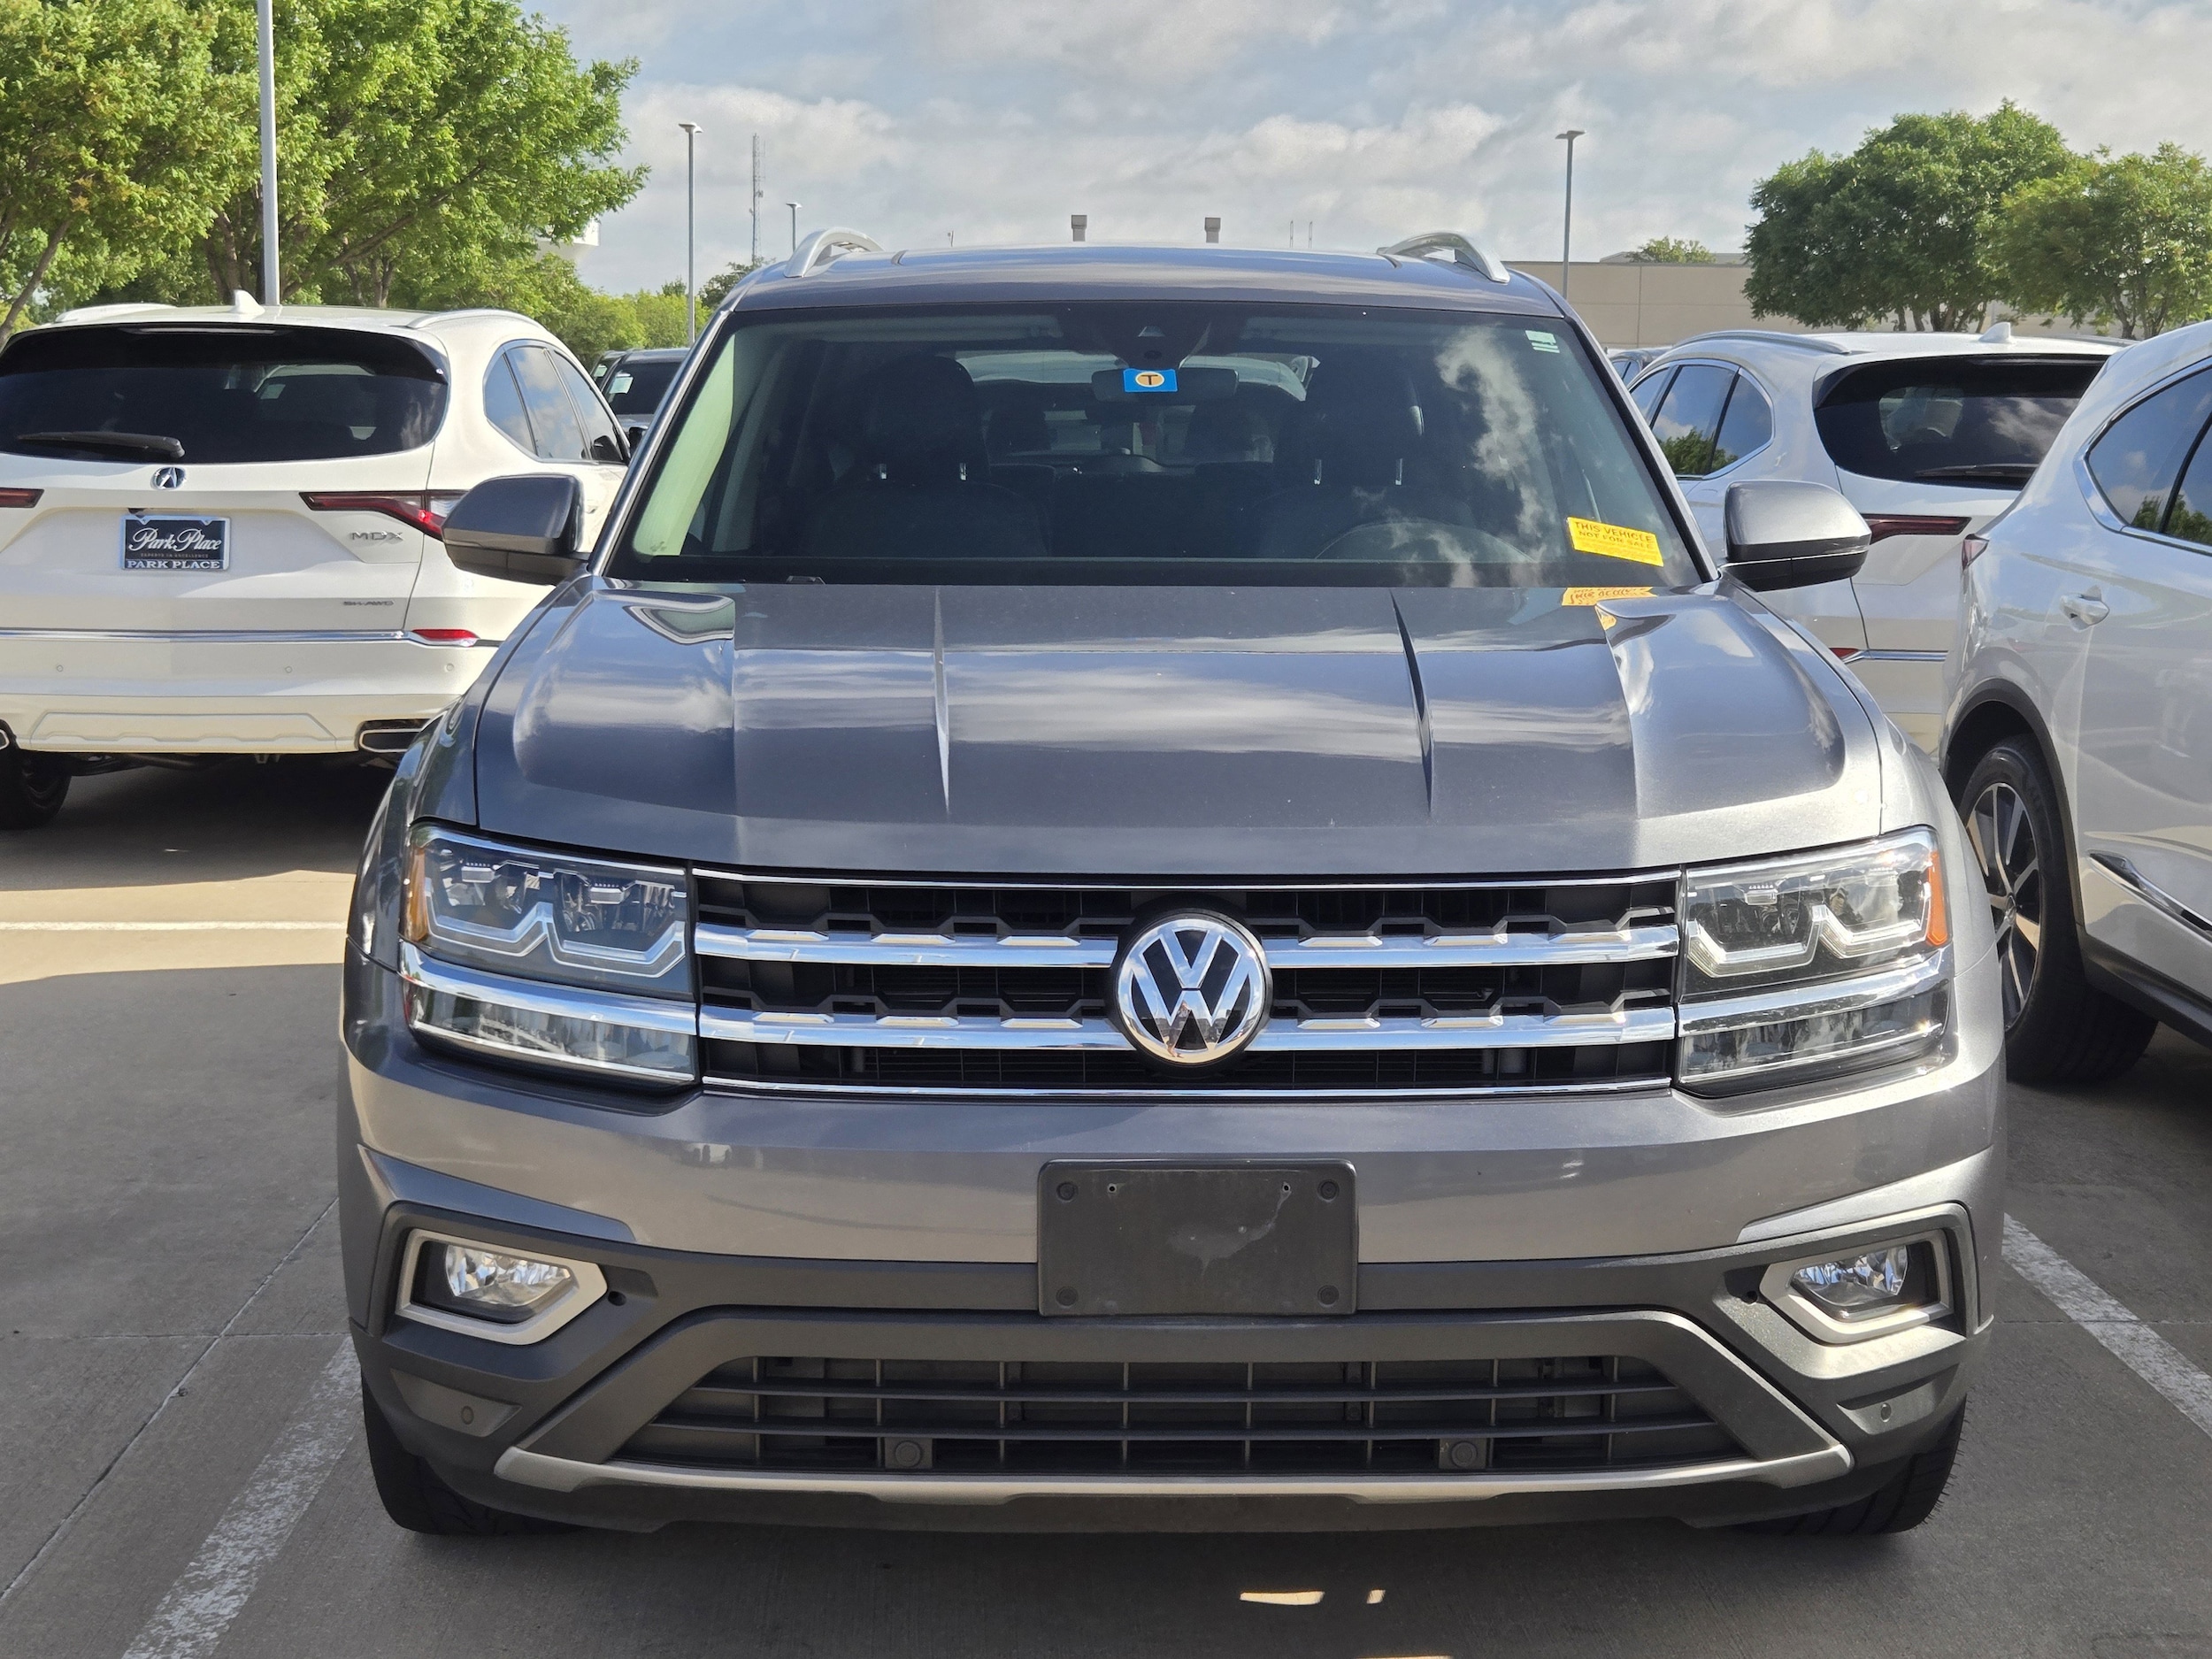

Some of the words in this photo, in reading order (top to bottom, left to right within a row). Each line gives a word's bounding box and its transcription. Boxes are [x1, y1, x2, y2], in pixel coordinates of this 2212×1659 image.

[1141, 374, 1158, 385] T
[351, 531, 403, 541] MDX
[1575, 521, 1601, 533] THIS
[1603, 527, 1654, 543] VEHICLE
[128, 527, 176, 551] Park
[173, 528, 222, 552] Place
[1602, 534, 1624, 543] FOR
[1627, 540, 1654, 549] SALE
[127, 560, 168, 569] PARK
